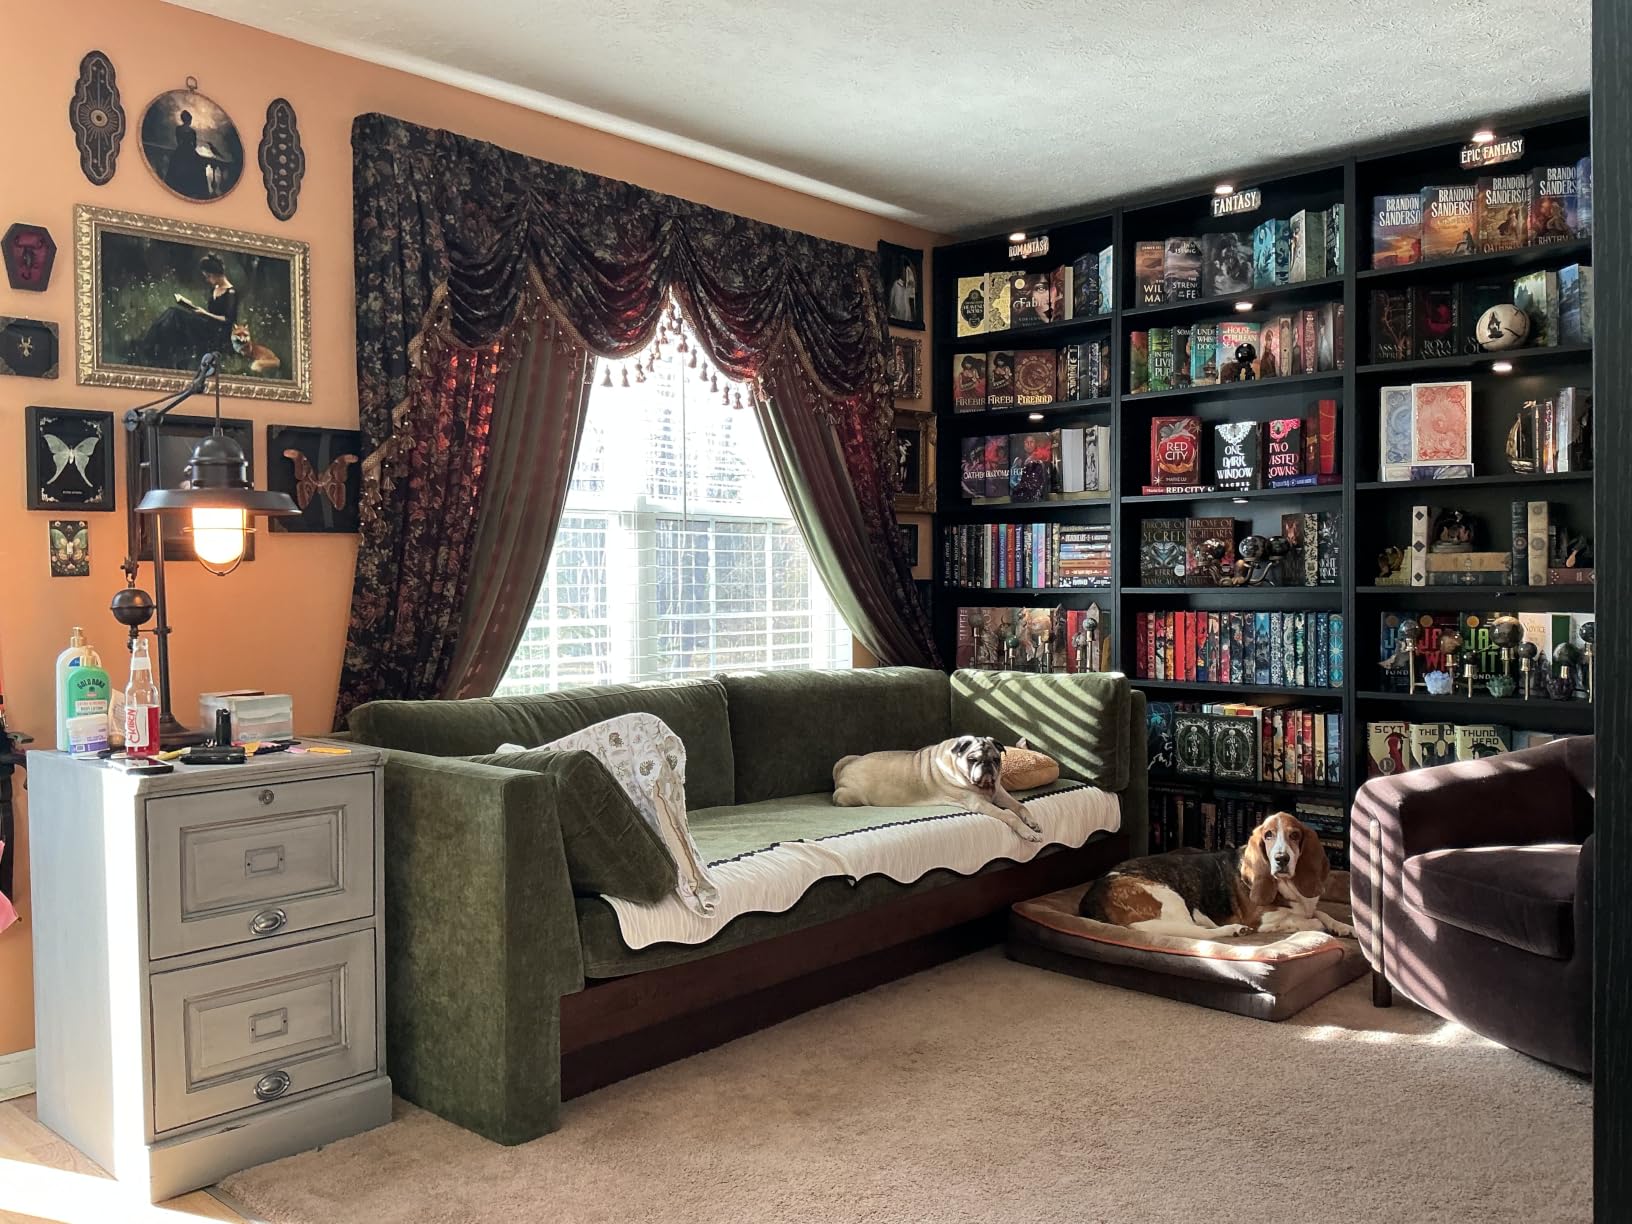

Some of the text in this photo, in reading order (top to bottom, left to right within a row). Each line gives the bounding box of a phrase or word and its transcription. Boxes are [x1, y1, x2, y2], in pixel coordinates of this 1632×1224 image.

[1461, 139, 1523, 164] EPIC FANTASY
[1547, 166, 1577, 181] BRANDO
[1492, 174, 1526, 191] BRANDON
[1540, 179, 1577, 197] SANDERS
[1438, 187, 1474, 203] BRANDON
[1486, 188, 1527, 205] SANDERSO
[1214, 191, 1257, 215] FANTASY
[1386, 197, 1420, 212] BRANDON
[1431, 200, 1474, 218] SANDERS
[1379, 209, 1422, 227] SANDERSO
[1008, 238, 1050, 258] ROMANTASY
[1143, 284, 1163, 294] WIL
[1186, 290, 1197, 299] FE
[1177, 328, 1190, 336] SOM
[1227, 326, 1250, 335] HOUSE
[1222, 334, 1257, 342] CERULEAN
[1222, 342, 1236, 350] SEA
[1424, 338, 1452, 350] ROYA
[1155, 368, 1171, 377] PUP
[955, 397, 986, 407] FIREBIR
[1017, 394, 1053, 405] FIREBIRD
[1166, 442, 1188, 451] RED
[1225, 444, 1245, 456] ONE
[1269, 442, 1289, 454] TWO
[1165, 451, 1189, 461] CITY
[1222, 455, 1247, 469] DARK
[1217, 467, 1253, 480] WINDOW
[1166, 486, 1183, 494] RED
[1184, 485, 1205, 493] CITY
[1142, 520, 1170, 529] THRONE
[1189, 519, 1217, 529] THRONE
[1143, 530, 1186, 542] SECRETS
[1385, 669, 1409, 677] FOND
[76, 678, 106, 690] GOLD BOND
[1418, 728, 1438, 736] THE
[1462, 729, 1498, 737] THUND
[1472, 737, 1499, 746] HEAD
